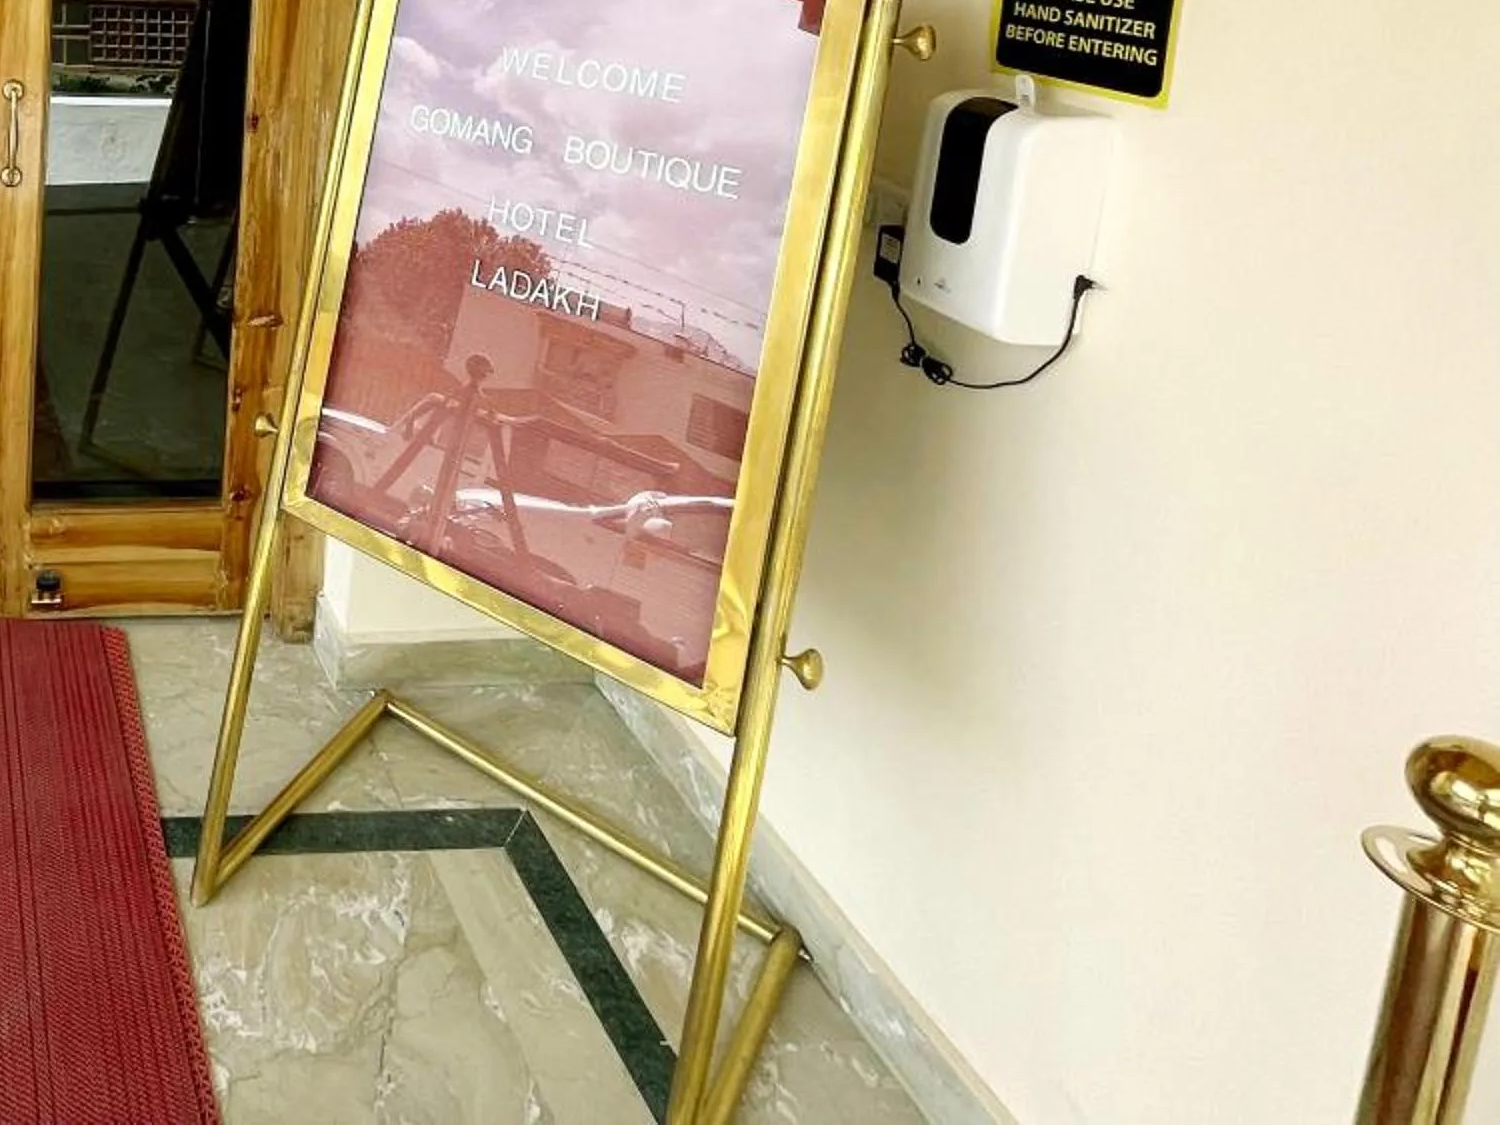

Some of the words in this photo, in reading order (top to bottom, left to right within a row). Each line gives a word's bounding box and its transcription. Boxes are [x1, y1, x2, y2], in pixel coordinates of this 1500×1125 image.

[1005, 24, 1065, 48] BEFORE
[1068, 35, 1158, 66] ENTERING
[1013, 1, 1061, 23] HAND
[1064, 9, 1156, 39] SANITIZER
[499, 46, 686, 104] WELCOME
[410, 104, 534, 155] GOMANG
[563, 135, 742, 200] BOUTIQUE
[486, 197, 595, 249] HOTEL
[470, 260, 601, 321] LADAKH
